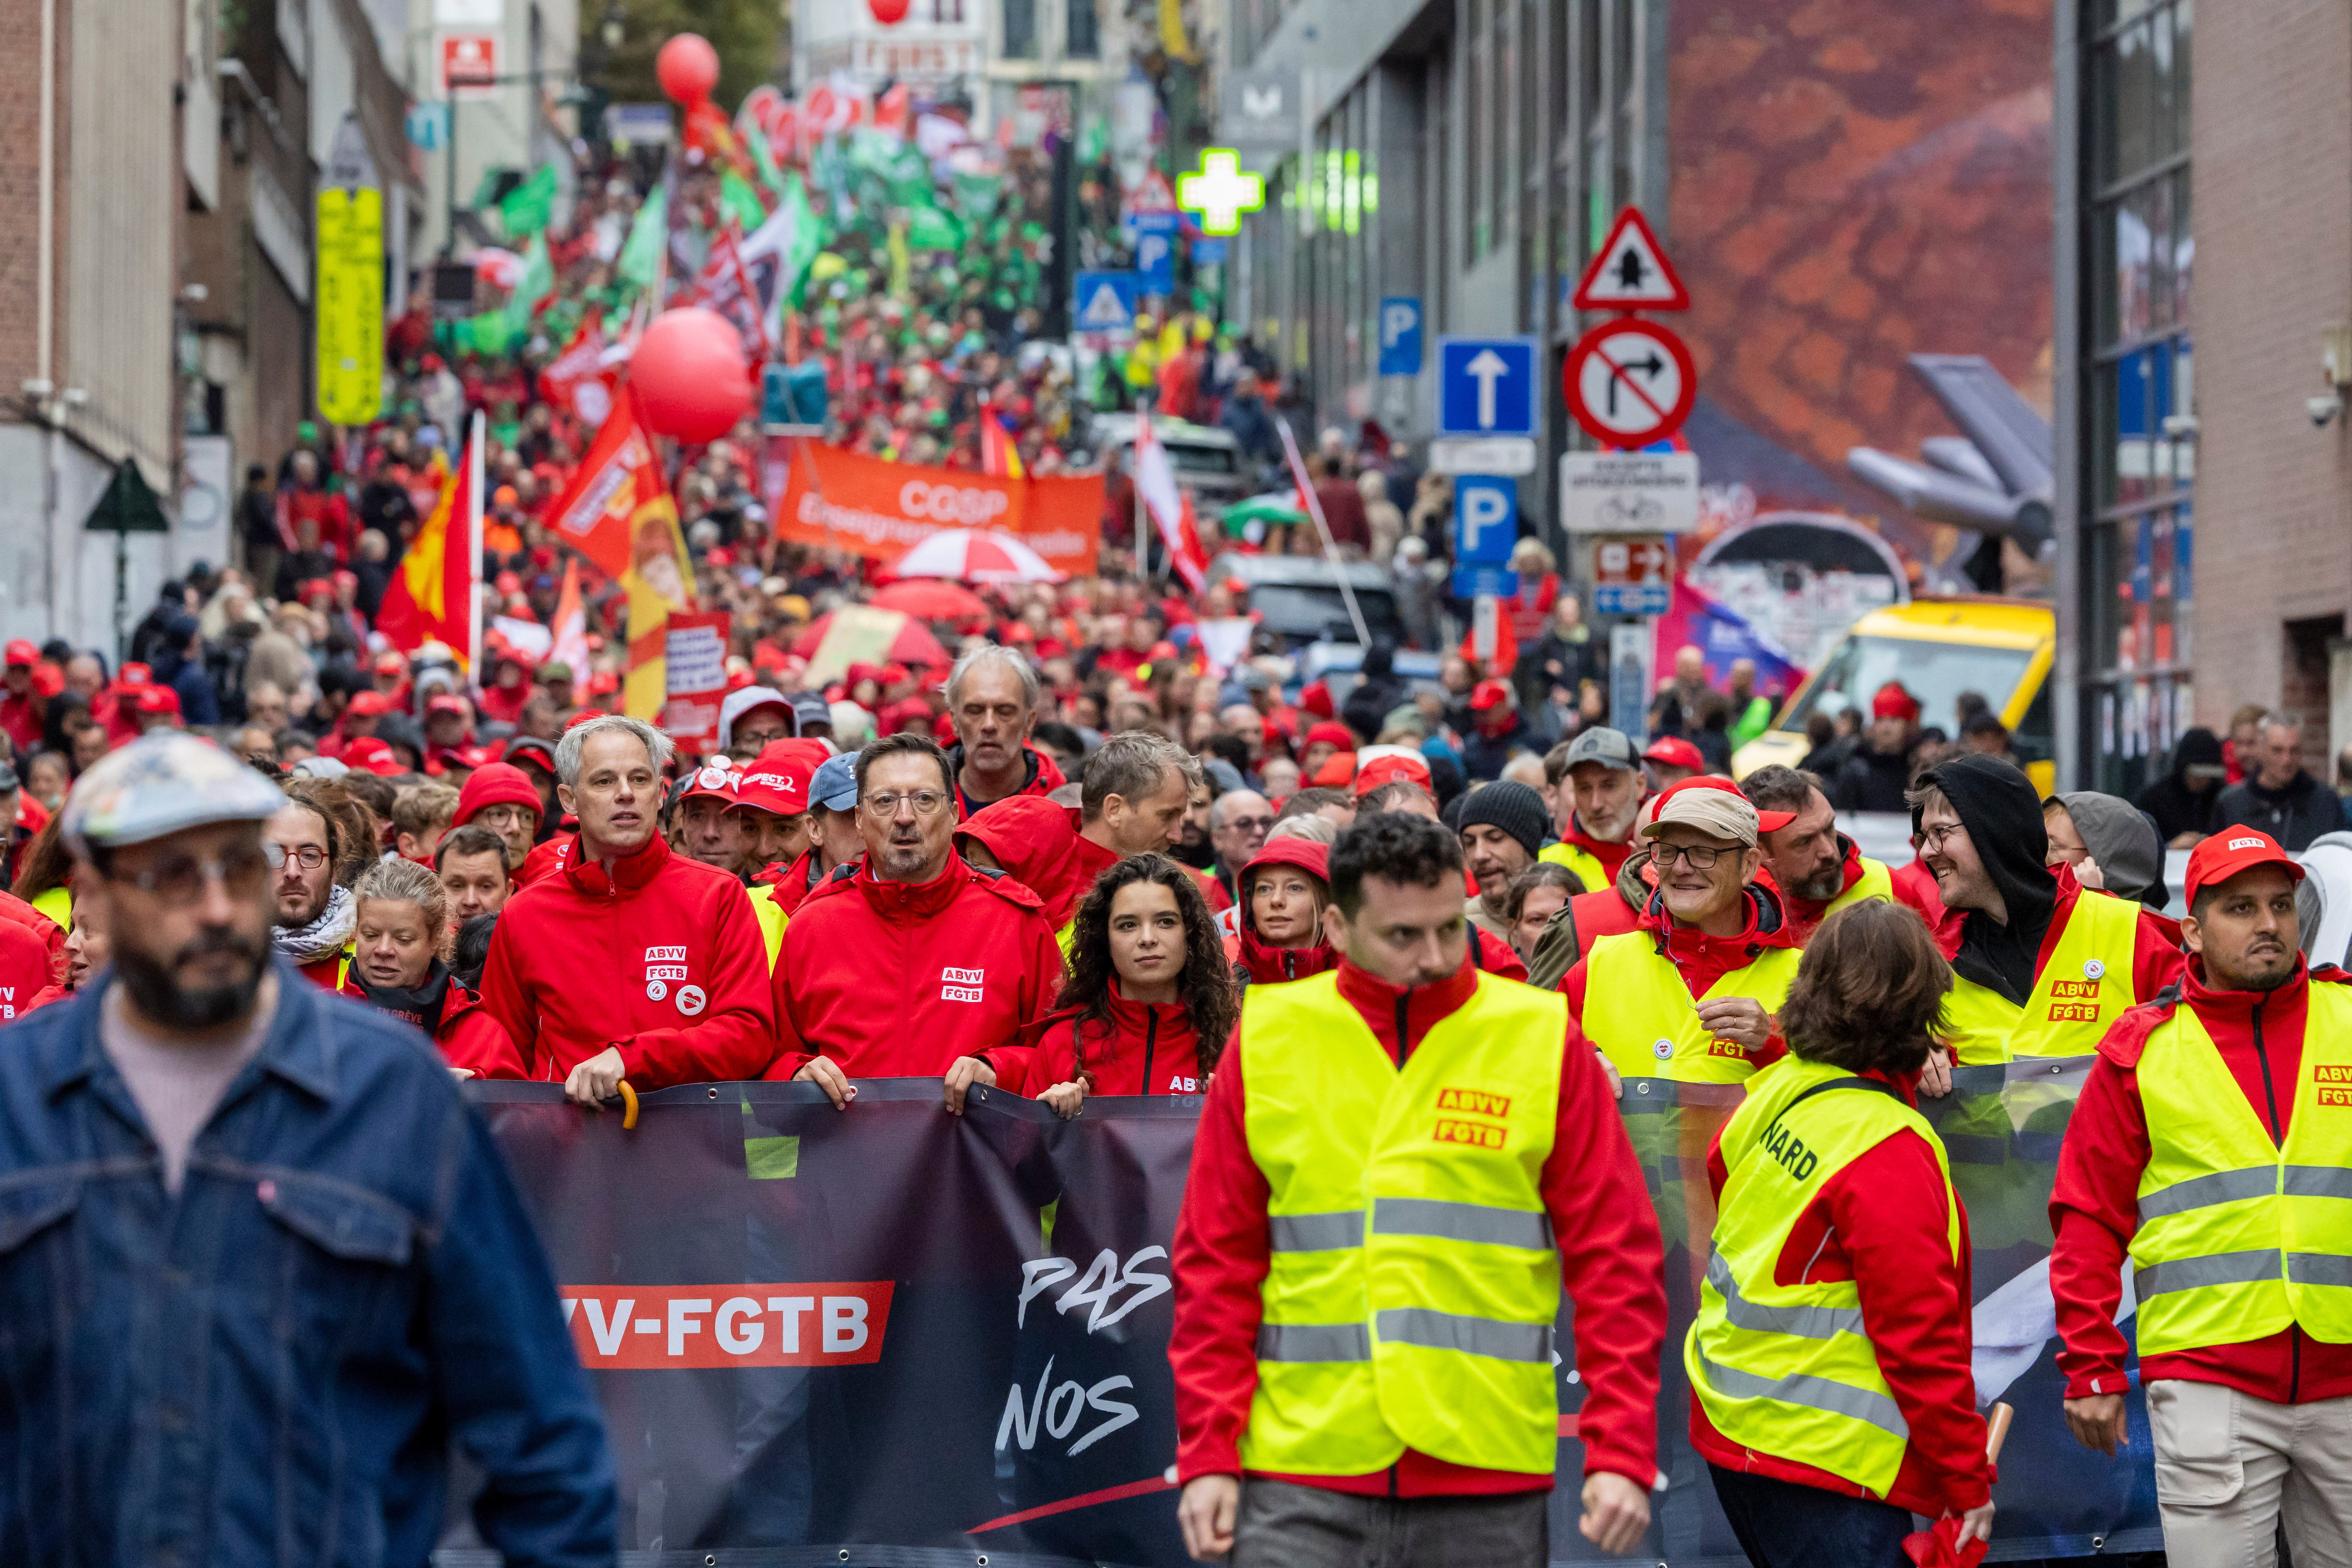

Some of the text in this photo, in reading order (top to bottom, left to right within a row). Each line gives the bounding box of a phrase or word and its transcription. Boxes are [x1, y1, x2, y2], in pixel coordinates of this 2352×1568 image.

[1384, 304, 1418, 348] P
[1462, 487, 1509, 551] P
[648, 948, 684, 959] ABVV
[650, 968, 684, 978] FGTB
[945, 970, 982, 981] ABVV
[946, 988, 980, 1000] FGTB
[2055, 983, 2096, 996] ABVV
[2053, 1006, 2095, 1019] FGTB
[1441, 1091, 1506, 1115] ABVV
[1439, 1121, 1502, 1147] FGTB
[1018, 1244, 1172, 1335] PAS
[995, 1354, 1139, 1457] NOS
